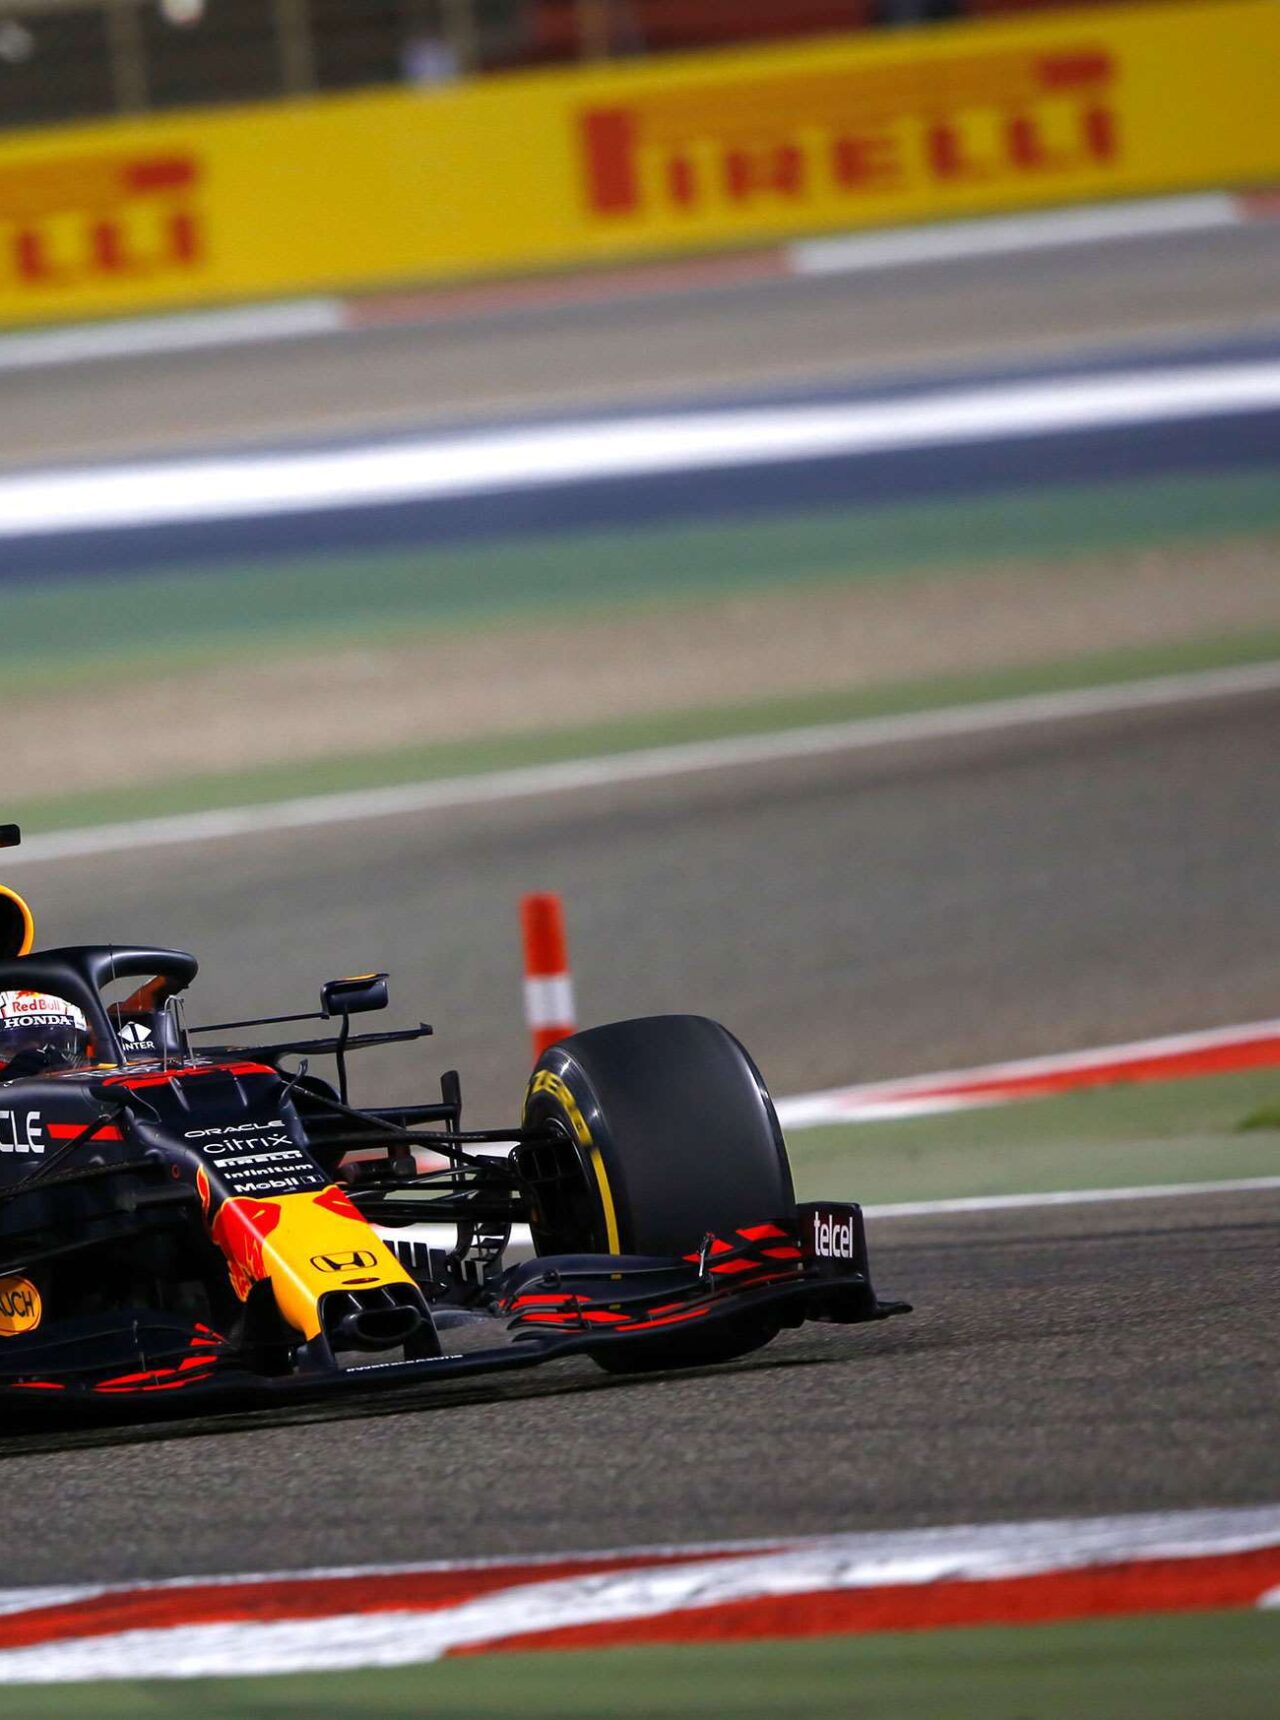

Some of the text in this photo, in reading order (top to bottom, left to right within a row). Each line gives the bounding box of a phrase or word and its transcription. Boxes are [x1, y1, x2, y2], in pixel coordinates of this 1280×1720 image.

[579, 48, 1117, 216] PIRELLI
[4, 1015, 72, 1029] HONDA
[122, 1040, 155, 1051] INTER
[184, 1119, 285, 1138] ORACLE
[213, 1149, 303, 1168] PIRELLI
[224, 1163, 314, 1180] infinitum
[233, 1177, 300, 1193] Mobil
[813, 1211, 853, 1258] telcel
